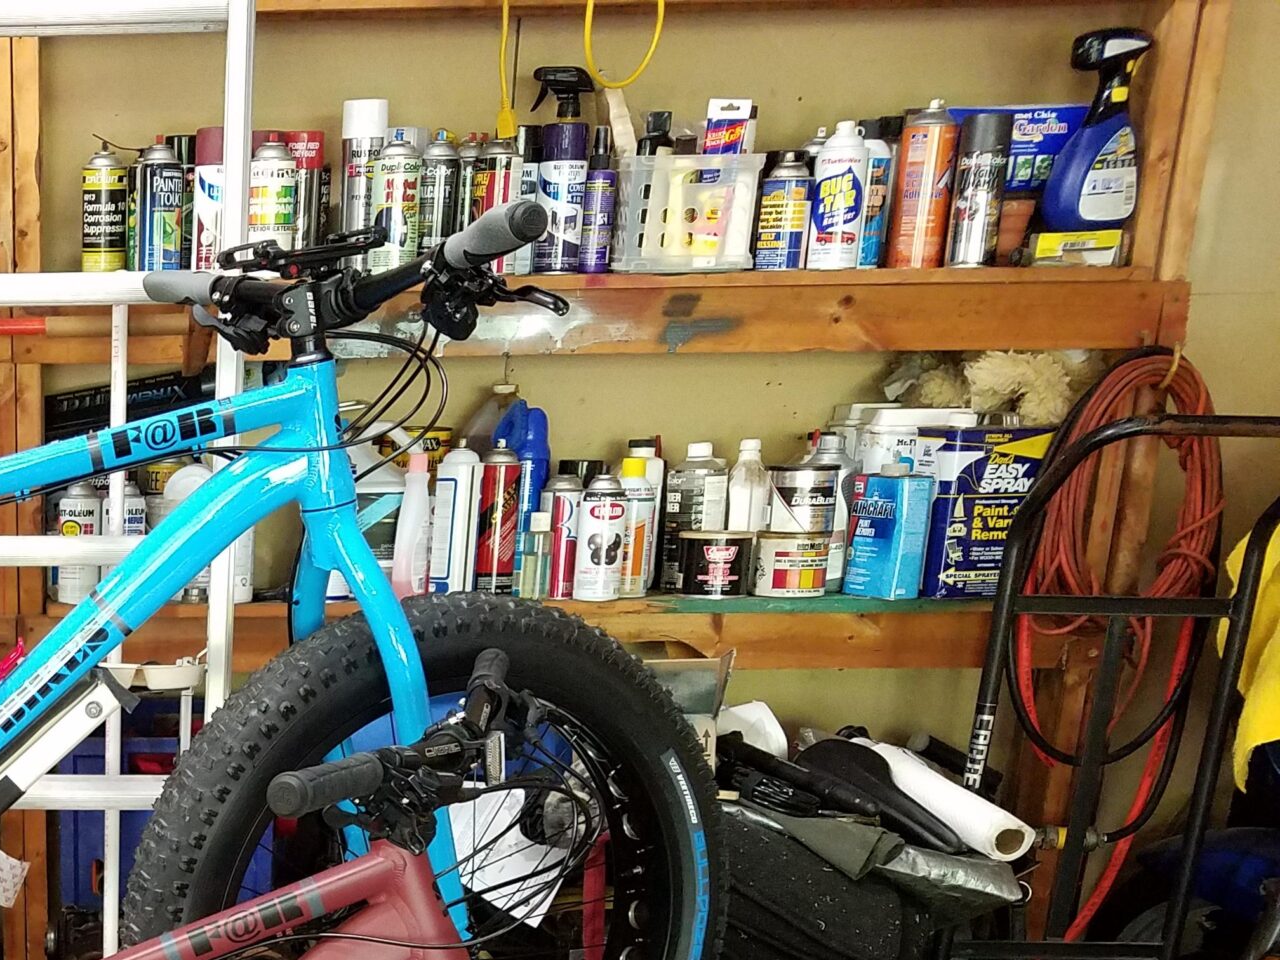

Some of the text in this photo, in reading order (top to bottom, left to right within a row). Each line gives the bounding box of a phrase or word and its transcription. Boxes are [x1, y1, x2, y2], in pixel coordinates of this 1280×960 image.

[1012, 119, 1069, 135] Garden
[83, 201, 116, 212] Formula
[83, 212, 122, 223] Corrosion
[982, 463, 1030, 479] EASY
[978, 477, 1035, 494] SPRAY
[851, 501, 897, 519] AIRCRAFT
[972, 517, 983, 529] &
[944, 571, 972, 580] SPECIAL
